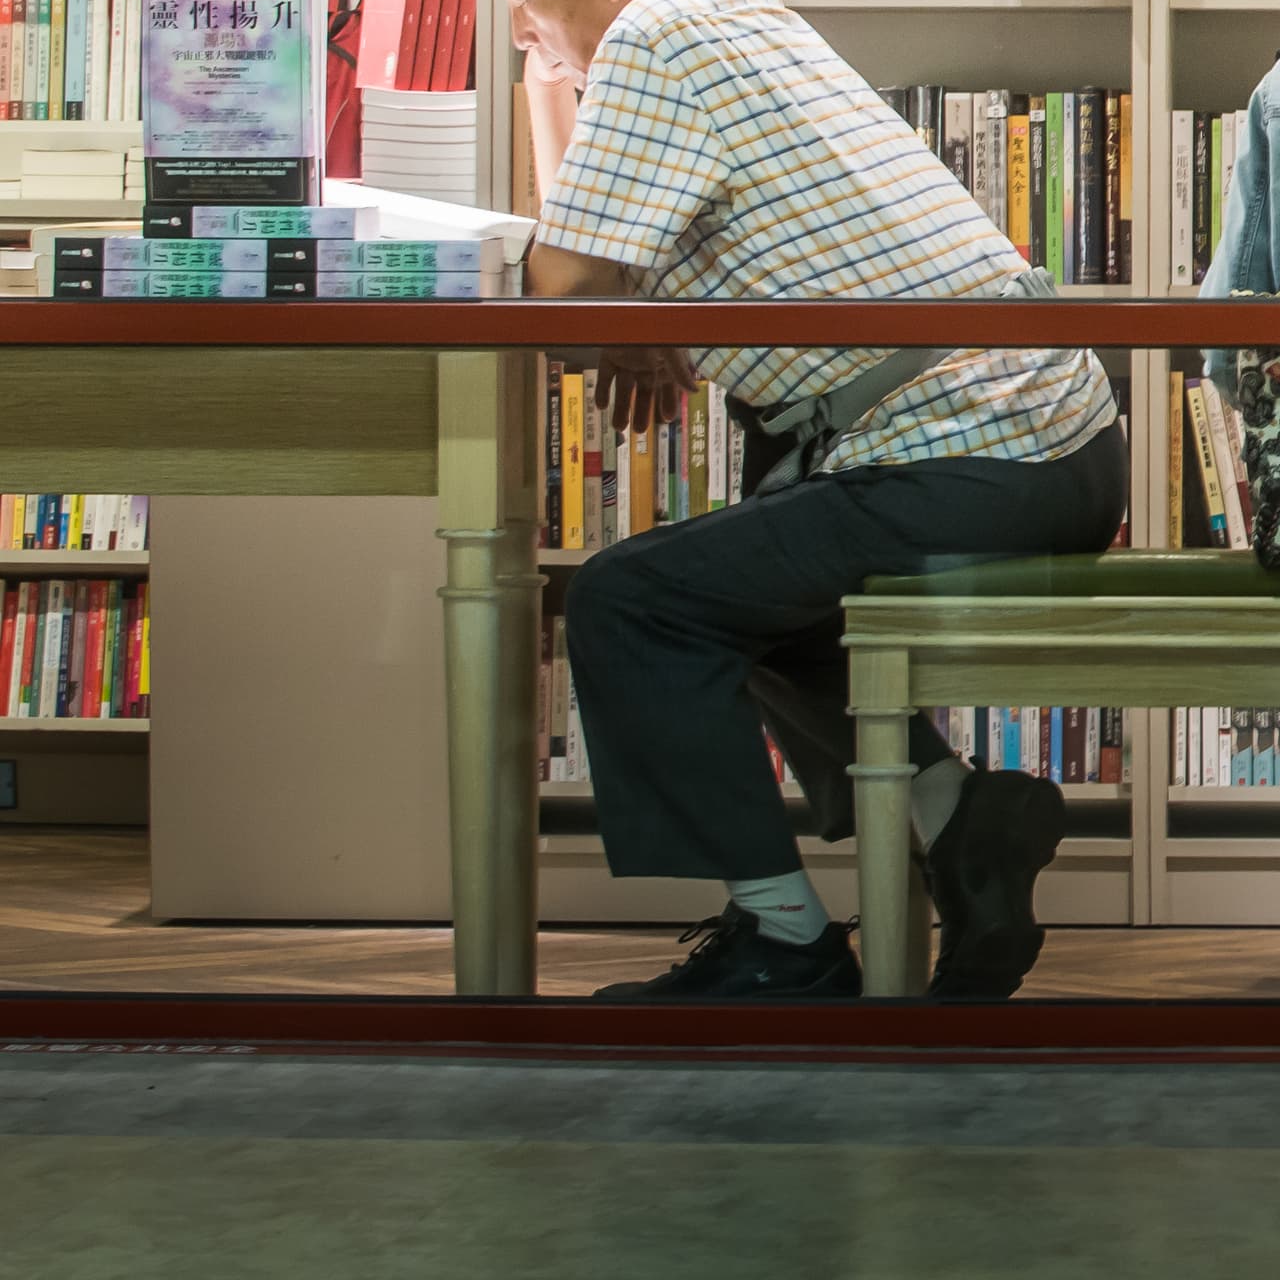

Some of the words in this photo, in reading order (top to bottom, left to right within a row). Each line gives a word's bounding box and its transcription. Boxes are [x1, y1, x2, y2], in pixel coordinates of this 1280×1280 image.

[149, 0, 299, 30] 靈性揚升
[199, 65, 212, 73] The
